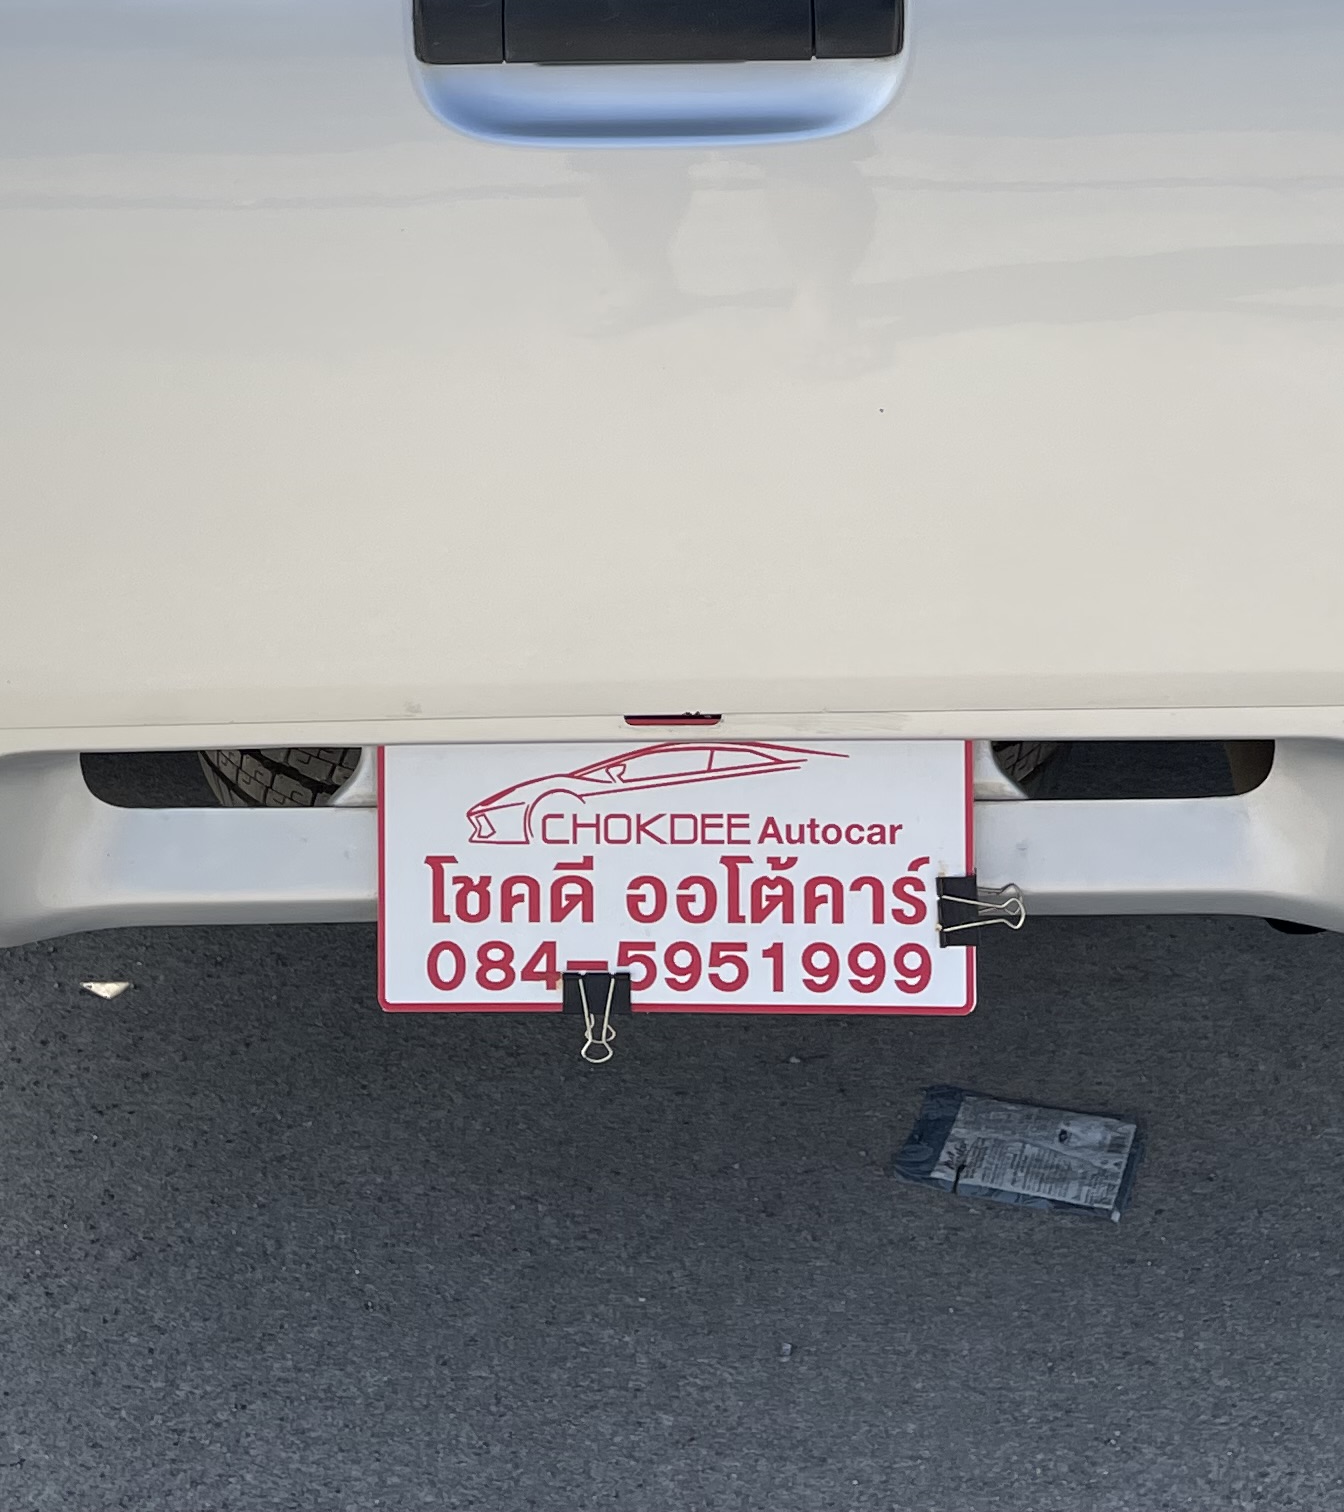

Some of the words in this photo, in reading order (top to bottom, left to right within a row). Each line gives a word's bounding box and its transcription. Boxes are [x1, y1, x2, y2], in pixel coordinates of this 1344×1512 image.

[541, 813, 750, 845] CHOKDEE
[757, 816, 903, 845] Autocar
[424, 855, 594, 924] โชคดี
[626, 856, 930, 925] ออโต้คาร์
[427, 940, 933, 993] 084-5951999
